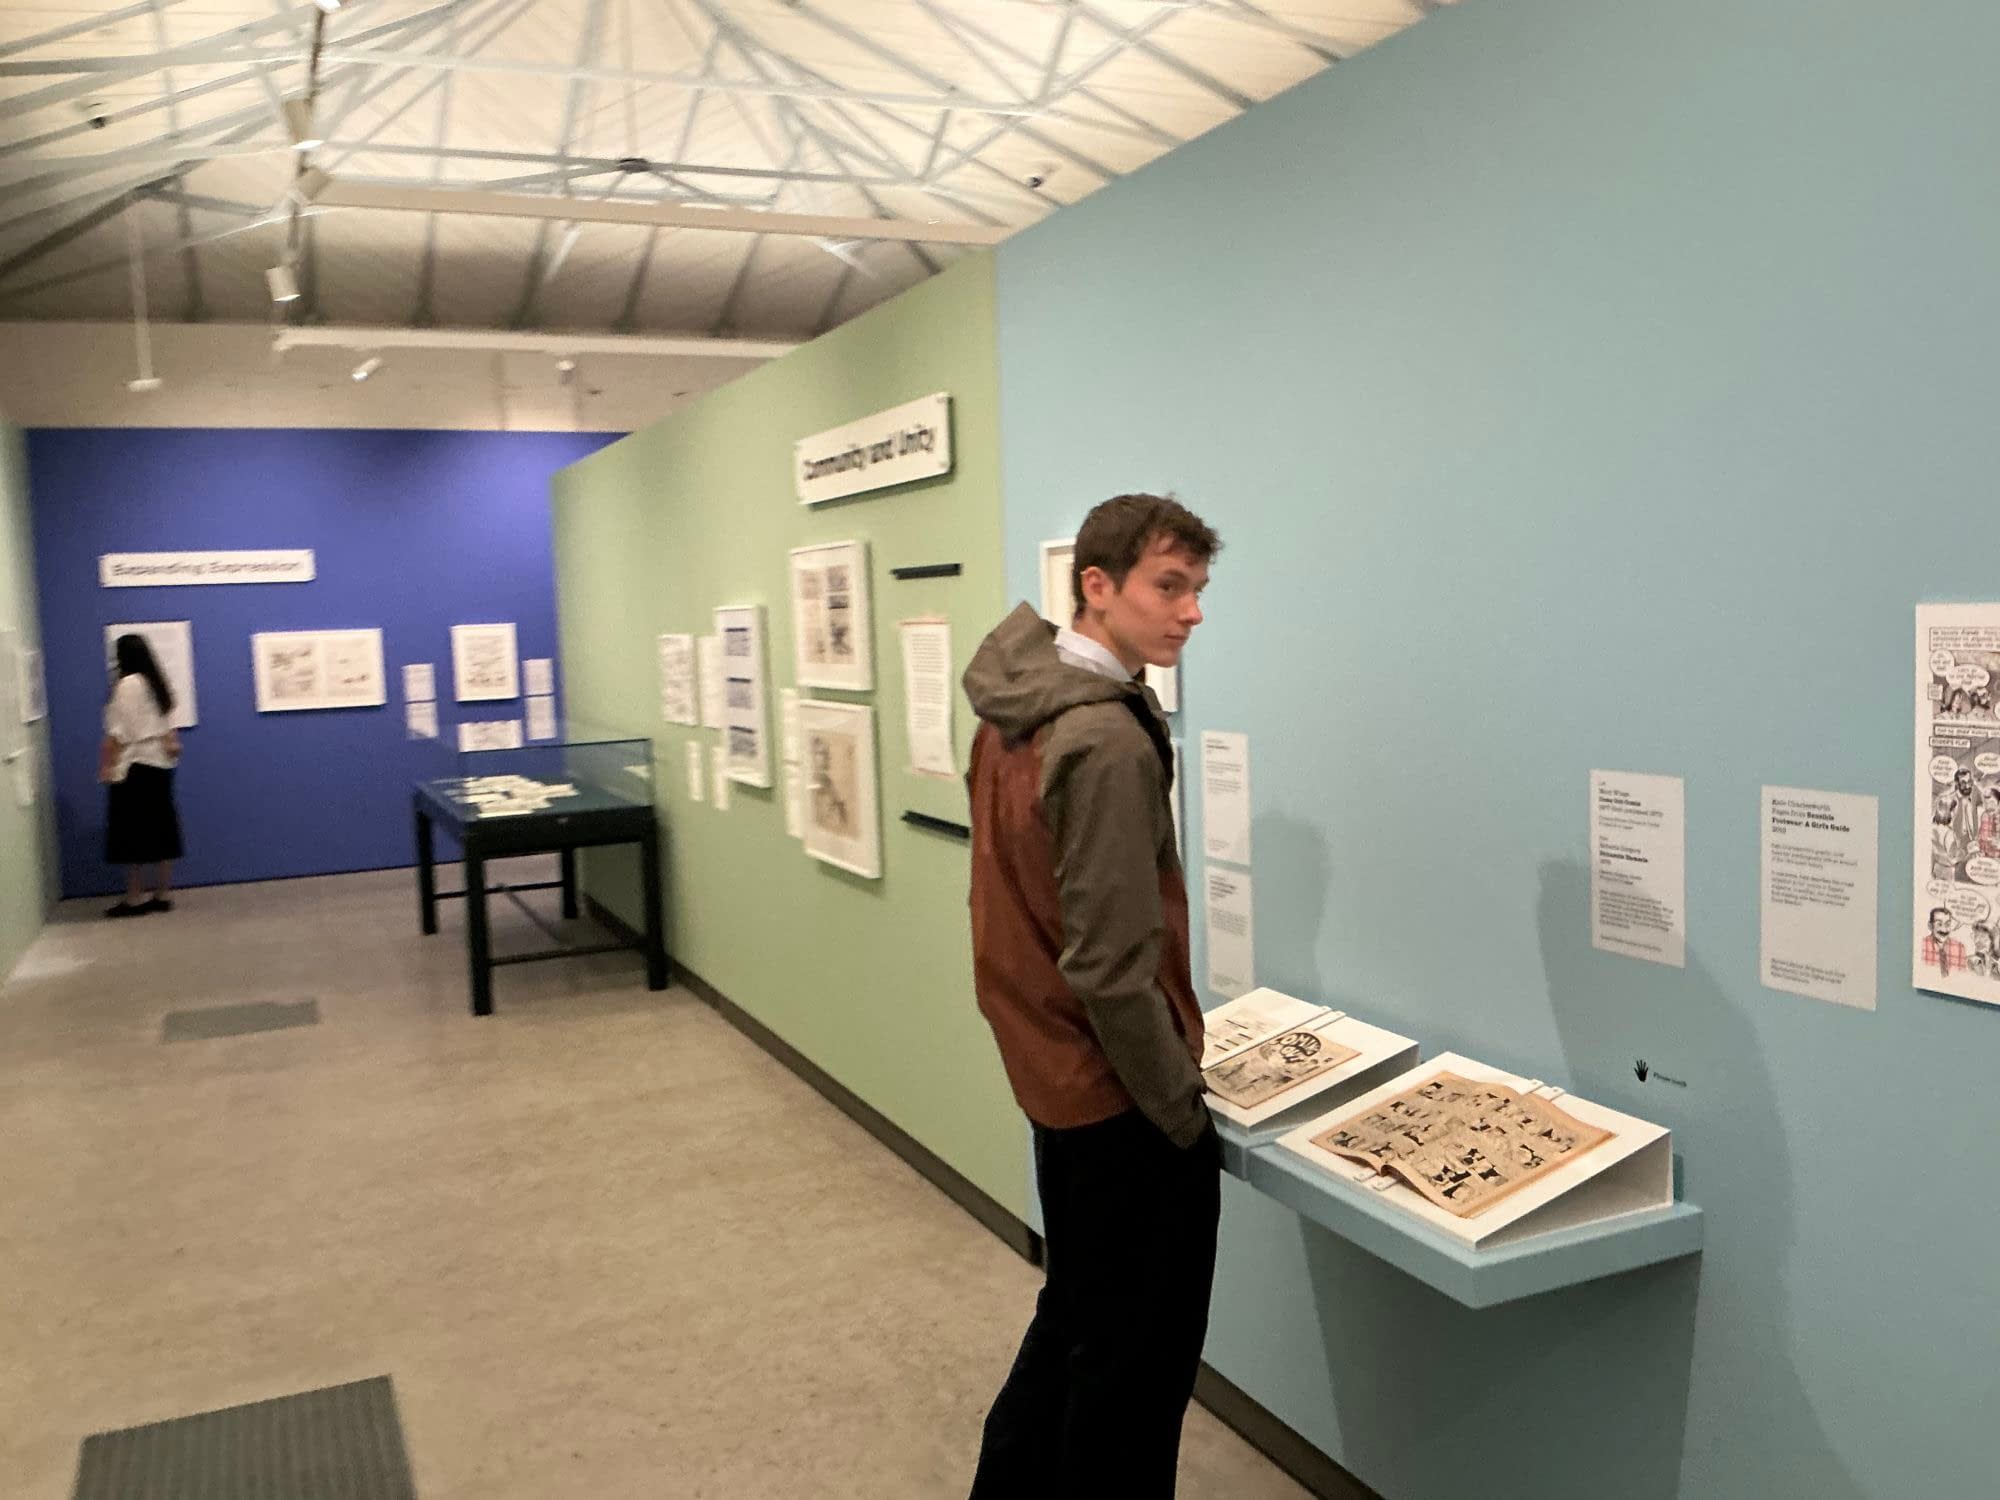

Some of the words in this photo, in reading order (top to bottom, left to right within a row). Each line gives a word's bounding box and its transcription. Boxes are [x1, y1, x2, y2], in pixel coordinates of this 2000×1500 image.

[803, 442, 866, 481] Community
[870, 435, 894, 465] and
[897, 423, 937, 454] Unity
[112, 563, 204, 577] Expanding
[208, 561, 301, 573] Expression
[1772, 808, 1789, 816] Pages
[1790, 809, 1806, 817] from
[1807, 812, 1834, 821] Sensible
[1830, 824, 1850, 832] Guide
